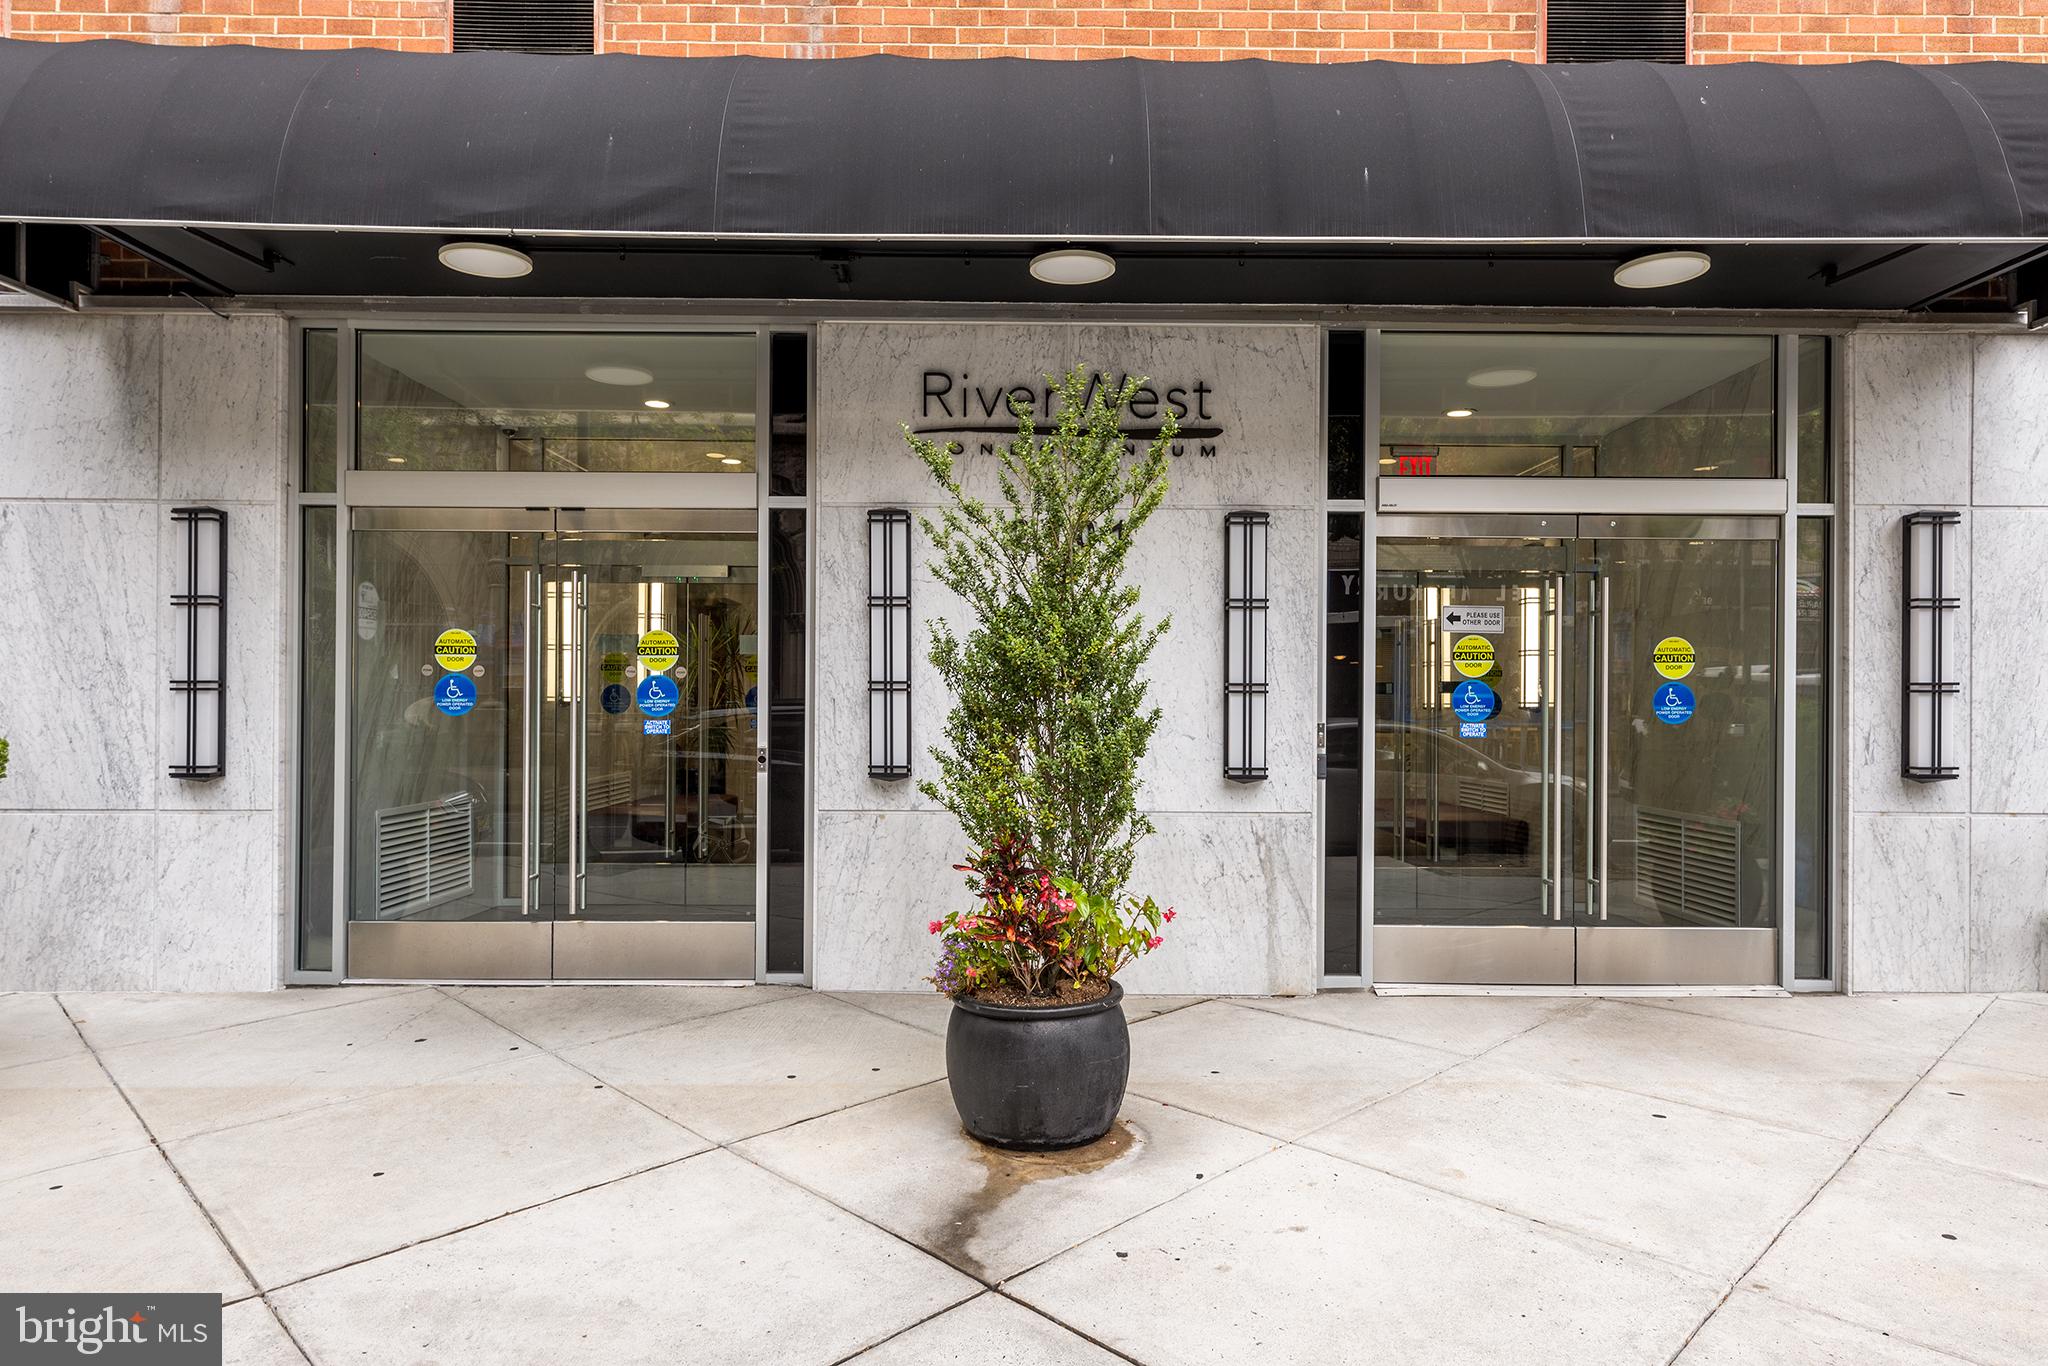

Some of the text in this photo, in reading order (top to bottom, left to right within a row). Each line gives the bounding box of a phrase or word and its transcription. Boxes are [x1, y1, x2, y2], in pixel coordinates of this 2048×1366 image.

[1399, 455, 1433, 477] EXIT
[435, 646, 476, 654] CAUTION
[638, 647, 678, 655] CAUTION
[1454, 652, 1493, 660] CAUTION
[1654, 654, 1694, 662] CAUTION
